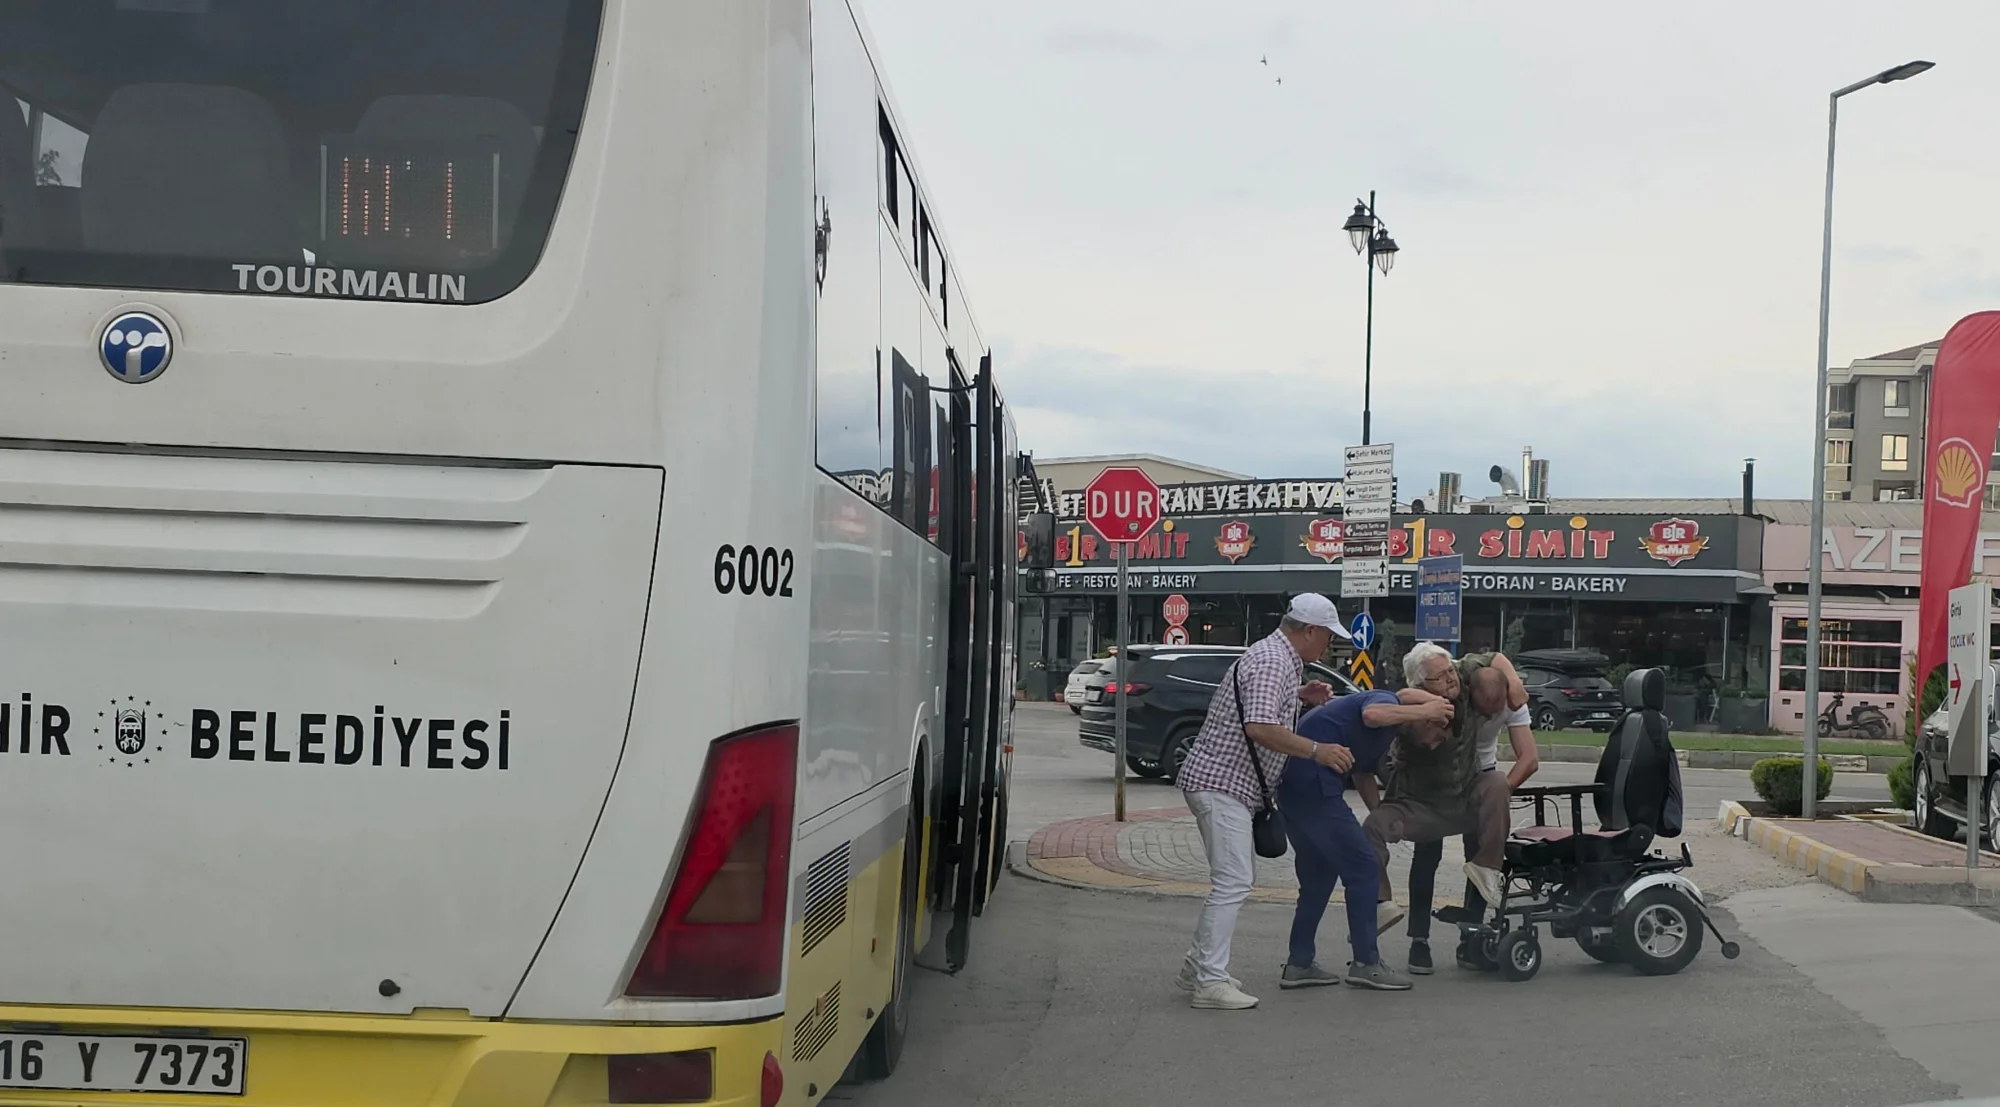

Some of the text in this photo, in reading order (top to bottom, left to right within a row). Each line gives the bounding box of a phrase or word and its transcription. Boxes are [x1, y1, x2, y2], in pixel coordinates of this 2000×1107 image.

[232, 264, 466, 301] TOURMALIN
[1092, 490, 1154, 519] DUR
[1212, 484, 1242, 510] VE
[714, 543, 794, 598] 6002
[1083, 575, 1142, 588] RESTOAN
[1152, 575, 1197, 588] BAKERY
[1552, 577, 1627, 592] BAKERY
[1165, 603, 1187, 616] DUR
[0, 693, 511, 770] İR BELEDİYESİ
[0, 1039, 235, 1087] 16 Y 7373
